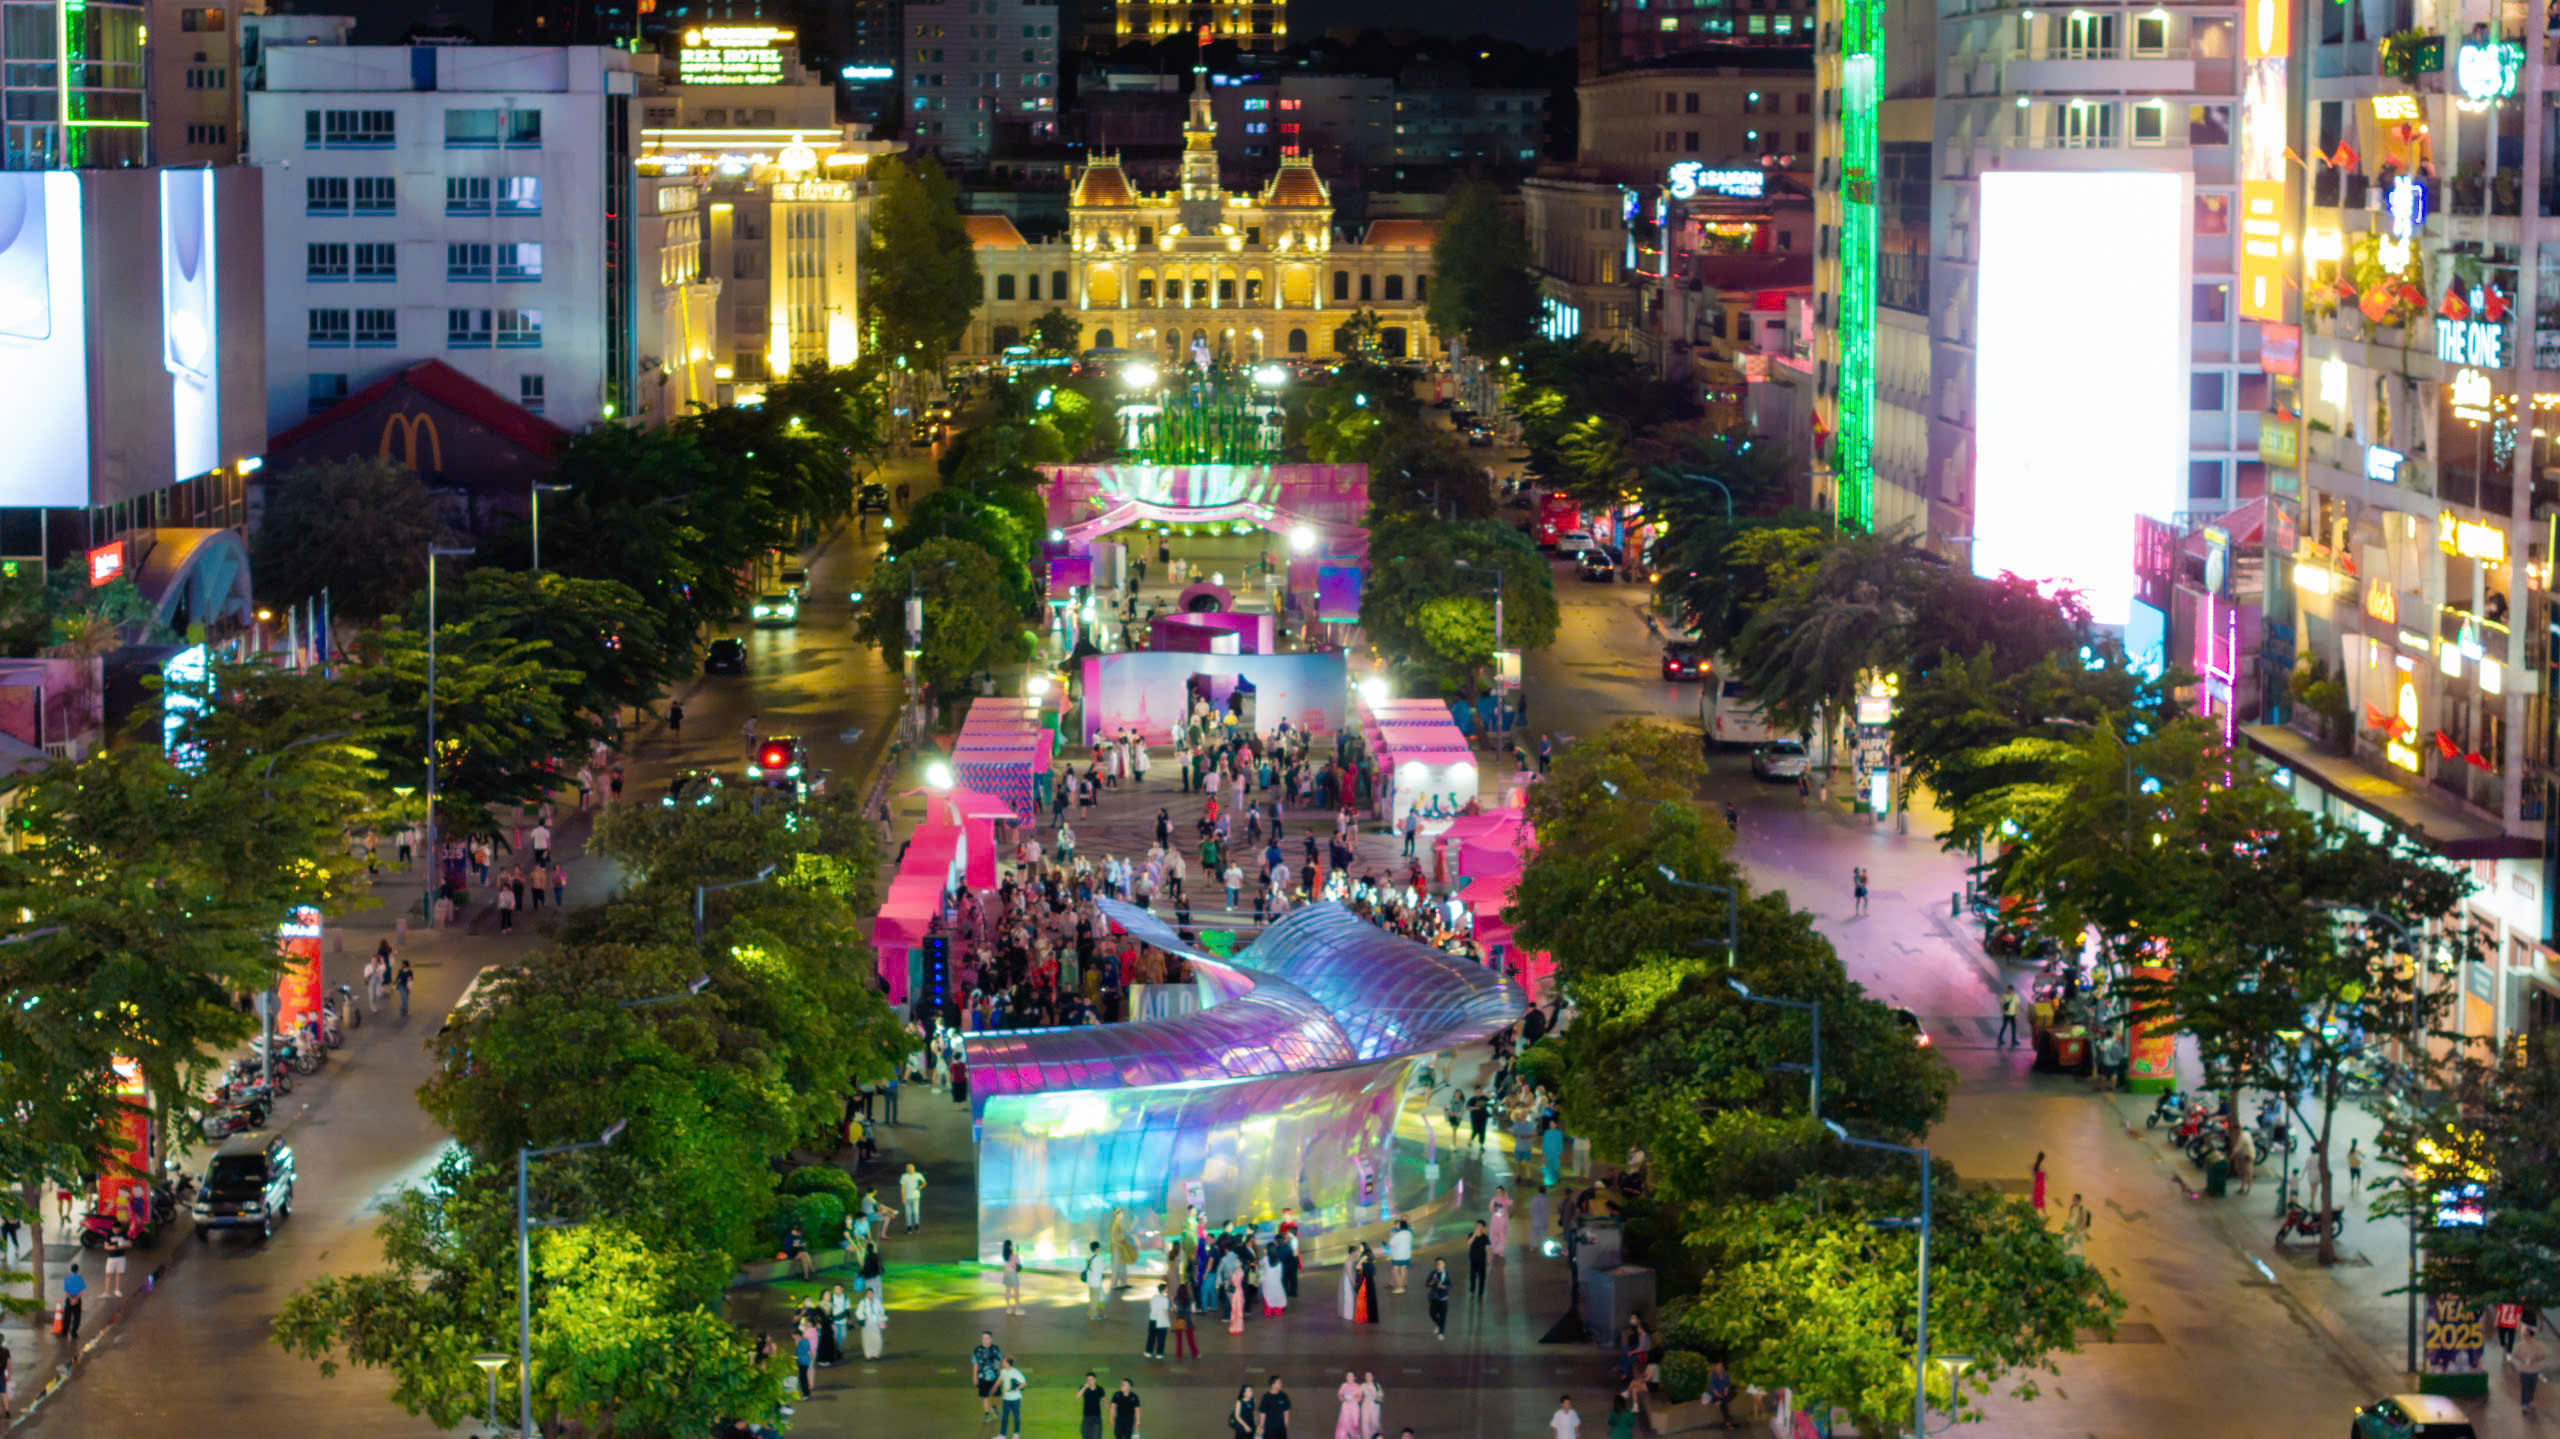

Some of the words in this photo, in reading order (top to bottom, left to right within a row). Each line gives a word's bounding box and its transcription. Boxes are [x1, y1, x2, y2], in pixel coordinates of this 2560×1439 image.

[681, 49, 721, 63] REX
[723, 49, 783, 63] HOTEL
[2436, 318, 2466, 364] THE
[2467, 321, 2502, 369] ONE
[2426, 1322, 2483, 1351] 2025
